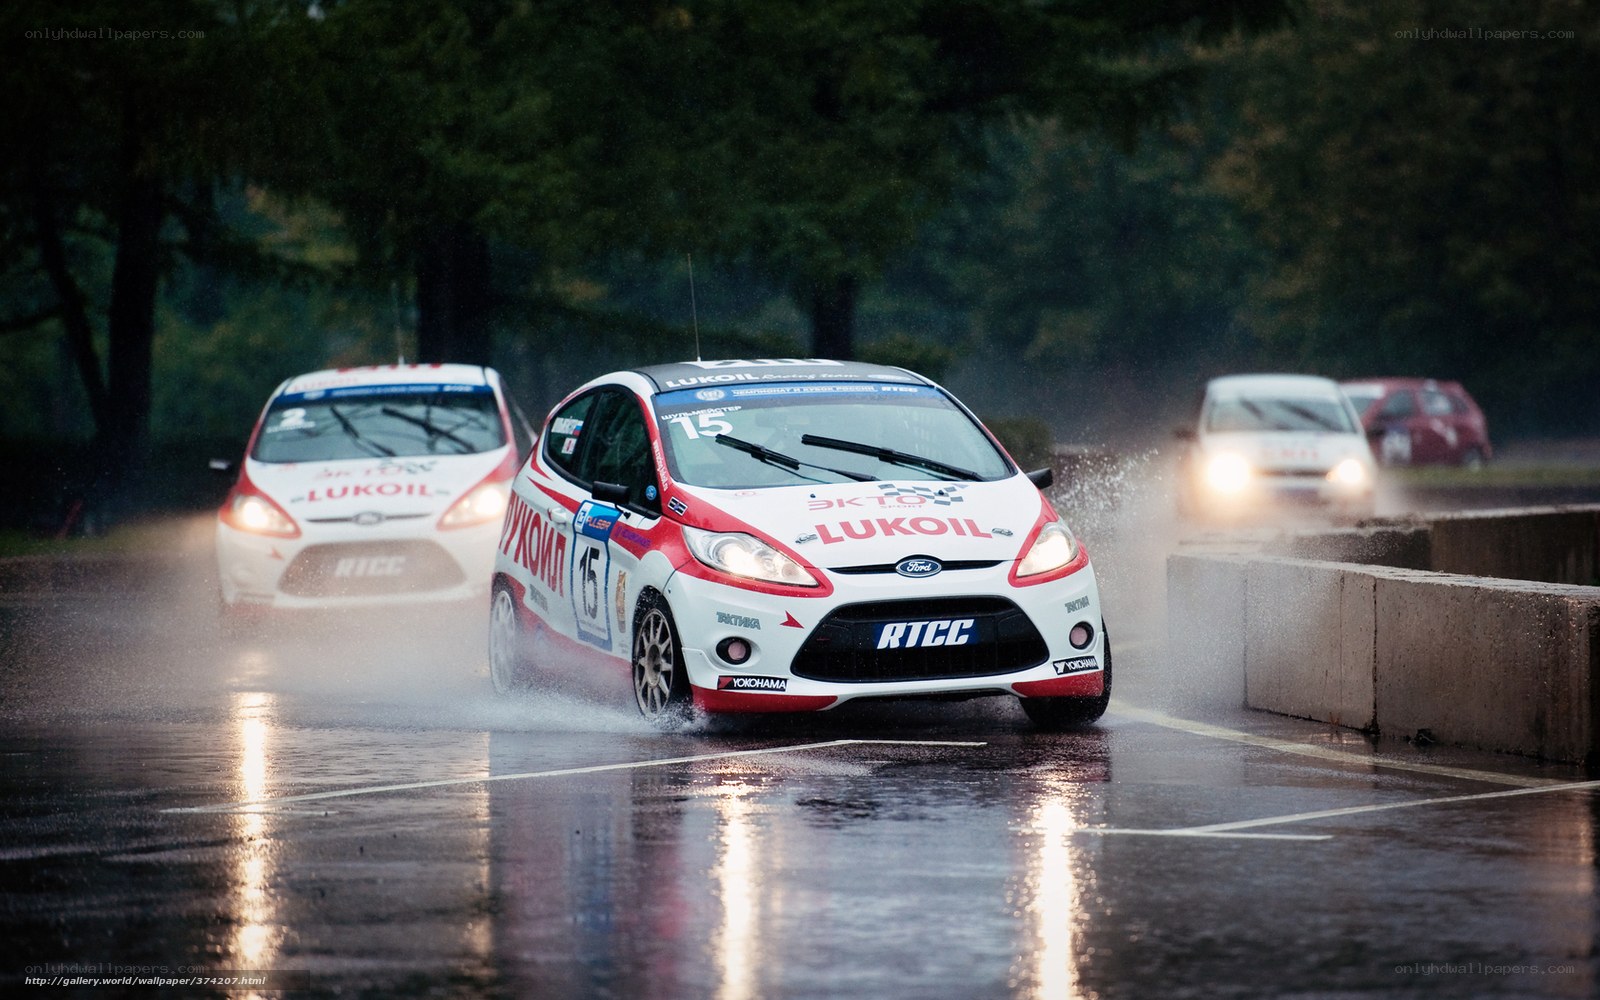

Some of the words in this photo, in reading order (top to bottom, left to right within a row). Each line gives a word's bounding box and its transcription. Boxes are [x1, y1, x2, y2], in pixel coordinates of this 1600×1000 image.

[665, 373, 760, 388] LUKOIL
[280, 407, 307, 427] 2
[670, 412, 734, 440] 15
[308, 482, 434, 502] LUKOIL
[815, 516, 993, 545] LUKOIL
[906, 561, 932, 573] Ford
[579, 546, 600, 620] 15
[716, 611, 762, 630] ТАКТИКА
[877, 618, 975, 650] RTCC
[732, 677, 787, 690] YOKOHAMA
